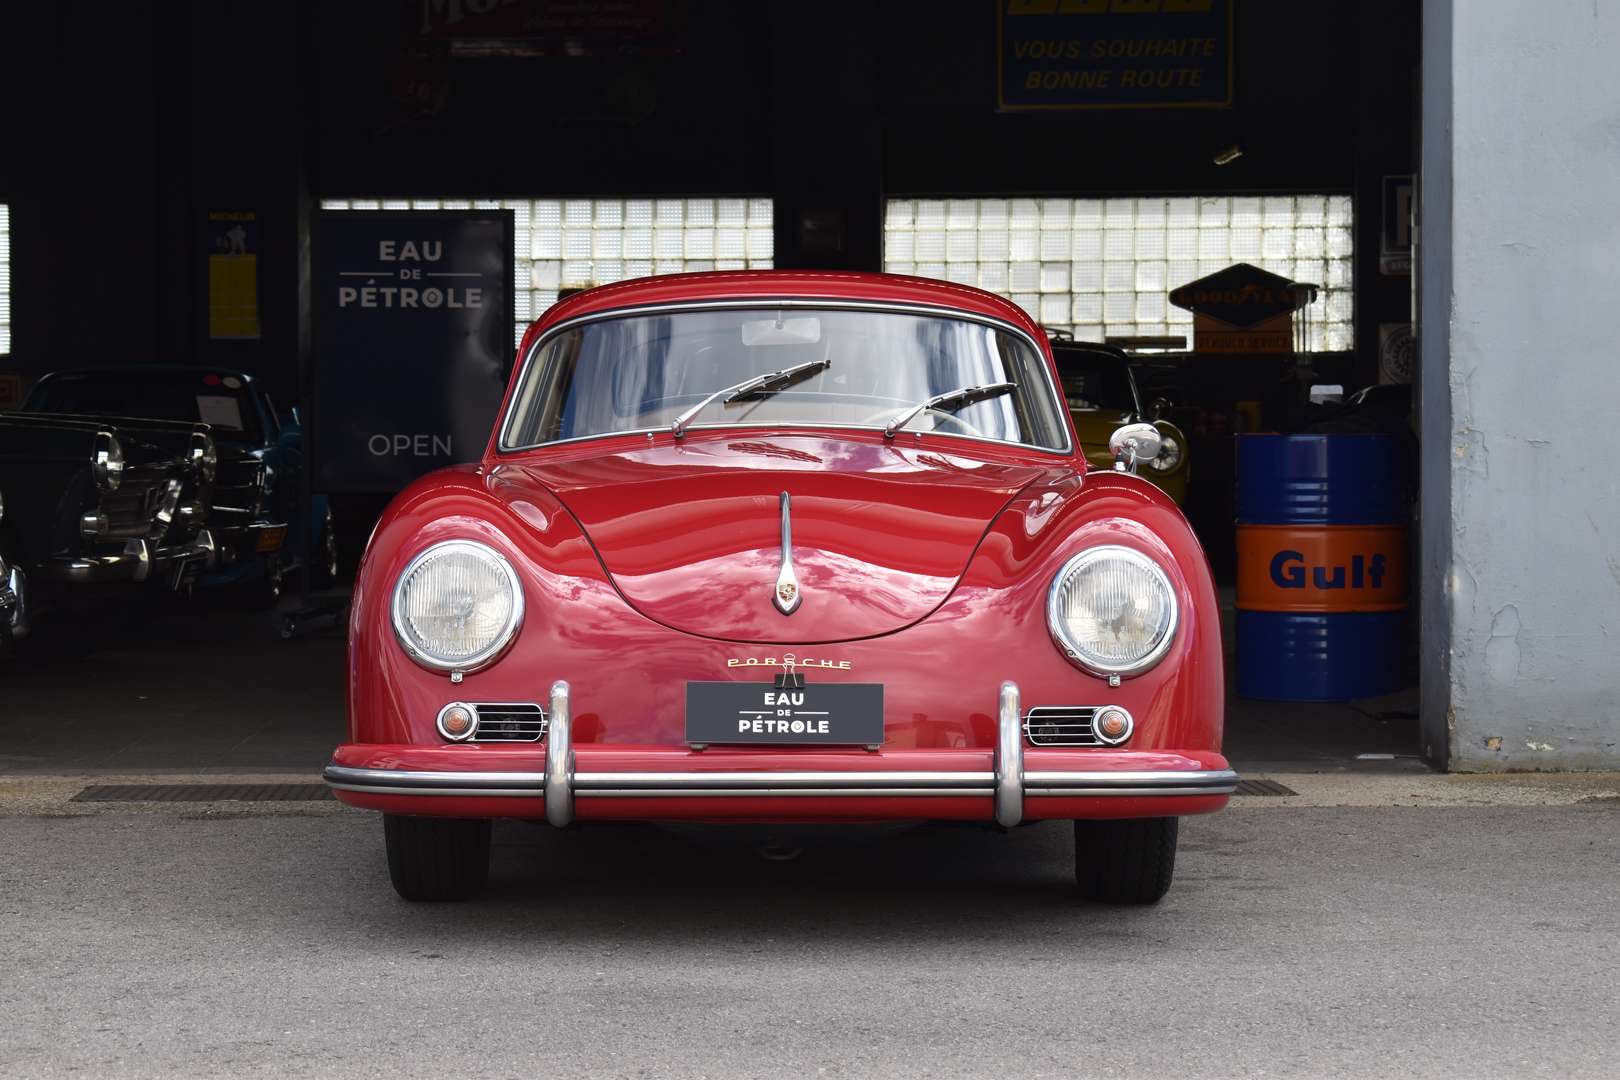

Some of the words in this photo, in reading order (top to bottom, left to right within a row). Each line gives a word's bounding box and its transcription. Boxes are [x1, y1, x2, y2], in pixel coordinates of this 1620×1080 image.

[1013, 39, 1081, 60] VOUS
[1089, 37, 1217, 59] SOUHAITE
[1024, 70, 1113, 90] BONNE
[1119, 68, 1204, 89] ROUTE
[379, 240, 443, 262] EAU
[399, 268, 422, 280] DE
[338, 278, 483, 309] PÉTROLE
[367, 433, 452, 457] OPEN
[1269, 549, 1387, 590] Gulf
[727, 656, 852, 670] PORSCHE
[763, 692, 805, 706] EAU
[776, 709, 792, 717] DE
[738, 715, 830, 734] PÉTROLE
